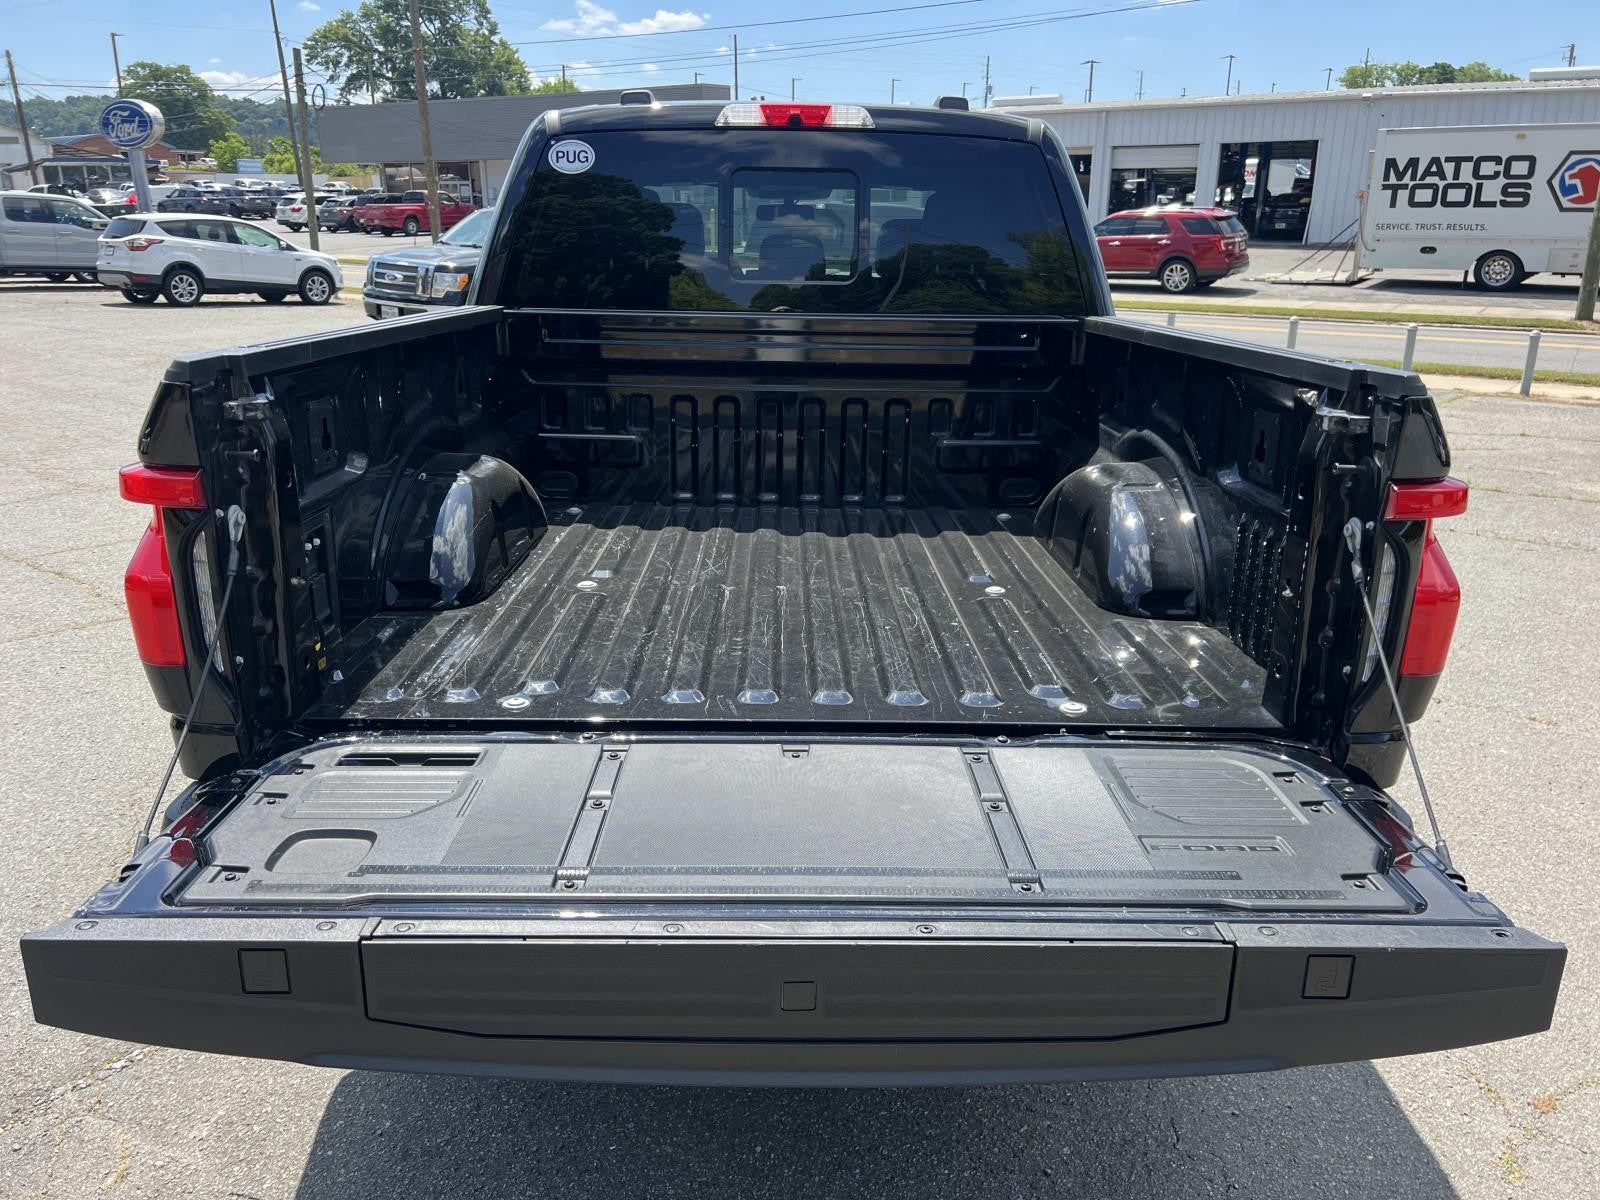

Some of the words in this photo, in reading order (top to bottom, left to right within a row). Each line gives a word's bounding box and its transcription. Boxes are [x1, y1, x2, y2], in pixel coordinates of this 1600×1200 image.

[109, 110, 142, 139] Ford
[555, 149, 590, 164] PUG
[1382, 154, 1538, 182] MATCO
[1380, 182, 1533, 209] TOOLS
[1375, 223, 1413, 231] SERVICE.
[1415, 223, 1444, 231] TRUST.
[1446, 223, 1488, 232] RESULTS.
